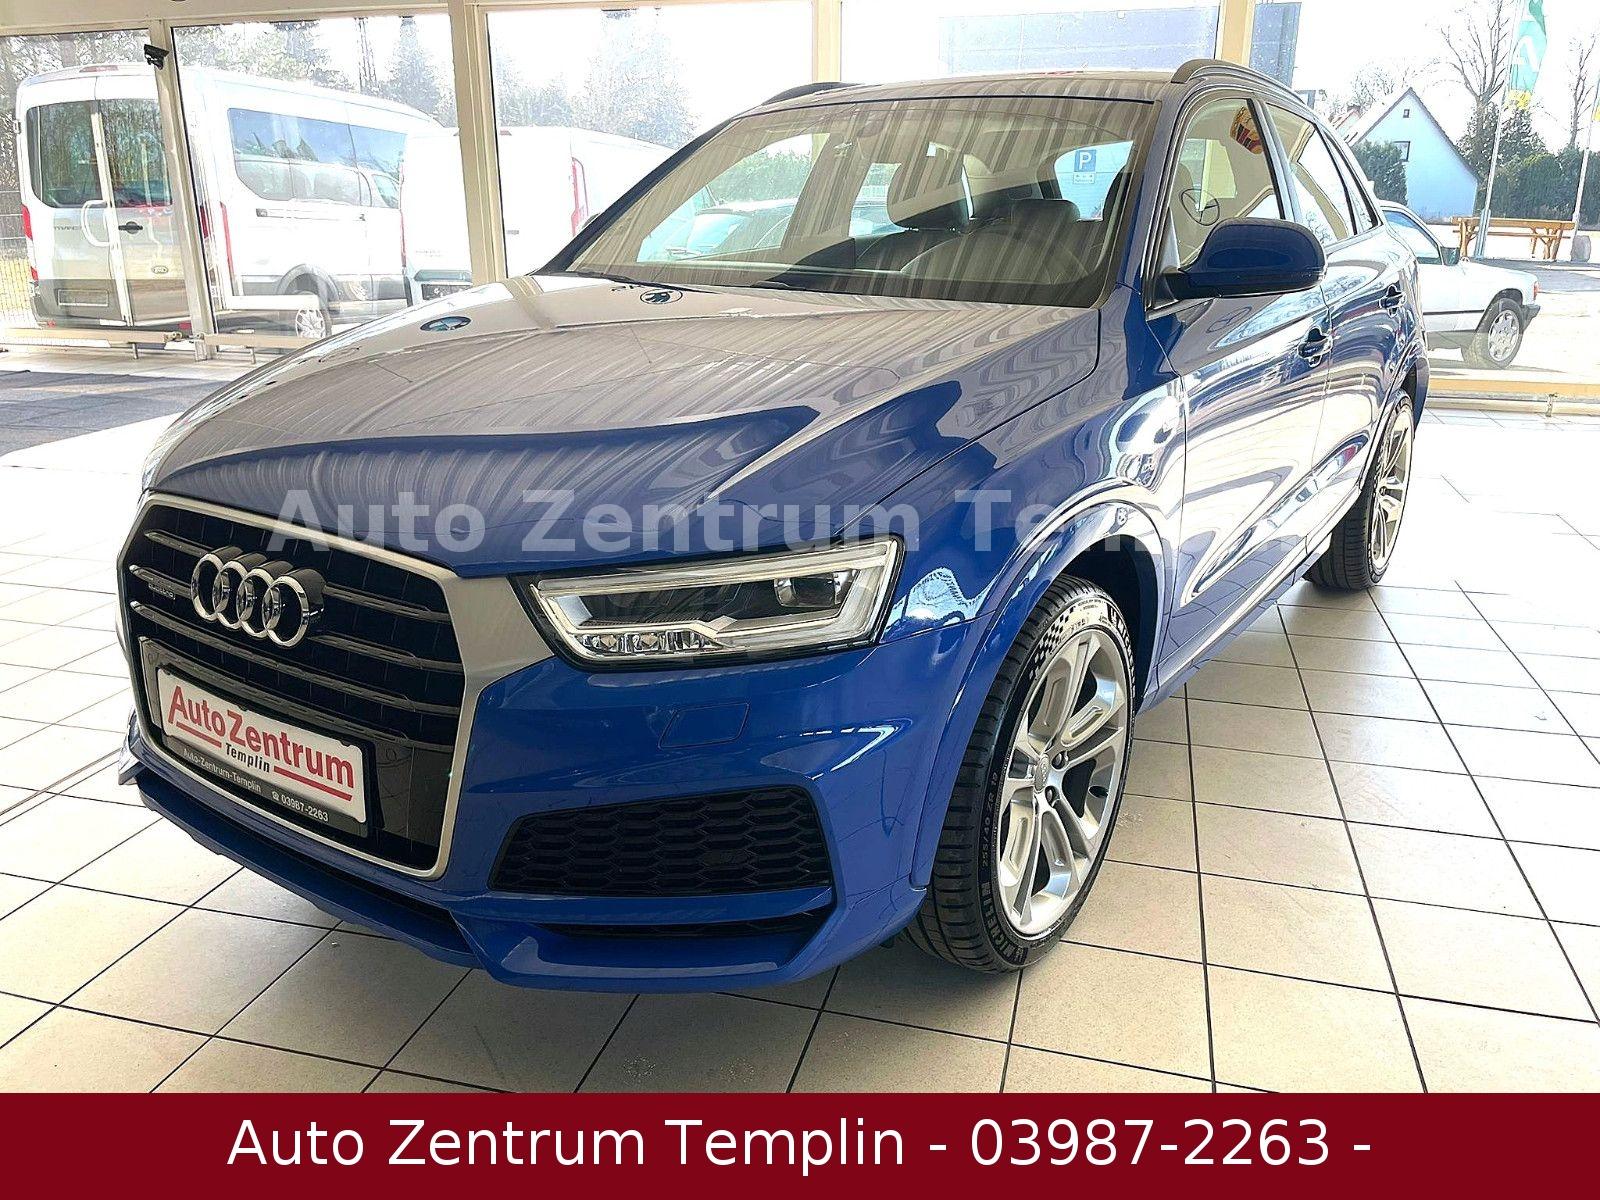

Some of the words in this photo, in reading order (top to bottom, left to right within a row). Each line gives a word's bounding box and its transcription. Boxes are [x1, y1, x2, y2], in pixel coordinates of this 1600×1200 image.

[1079, 151, 1092, 170] P
[225, 743, 271, 773] Templin
[183, 749, 262, 793] Auto-Zentrum-Templin
[281, 794, 329, 822] 03987-2263
[981, 881, 1016, 957] MICHELIN
